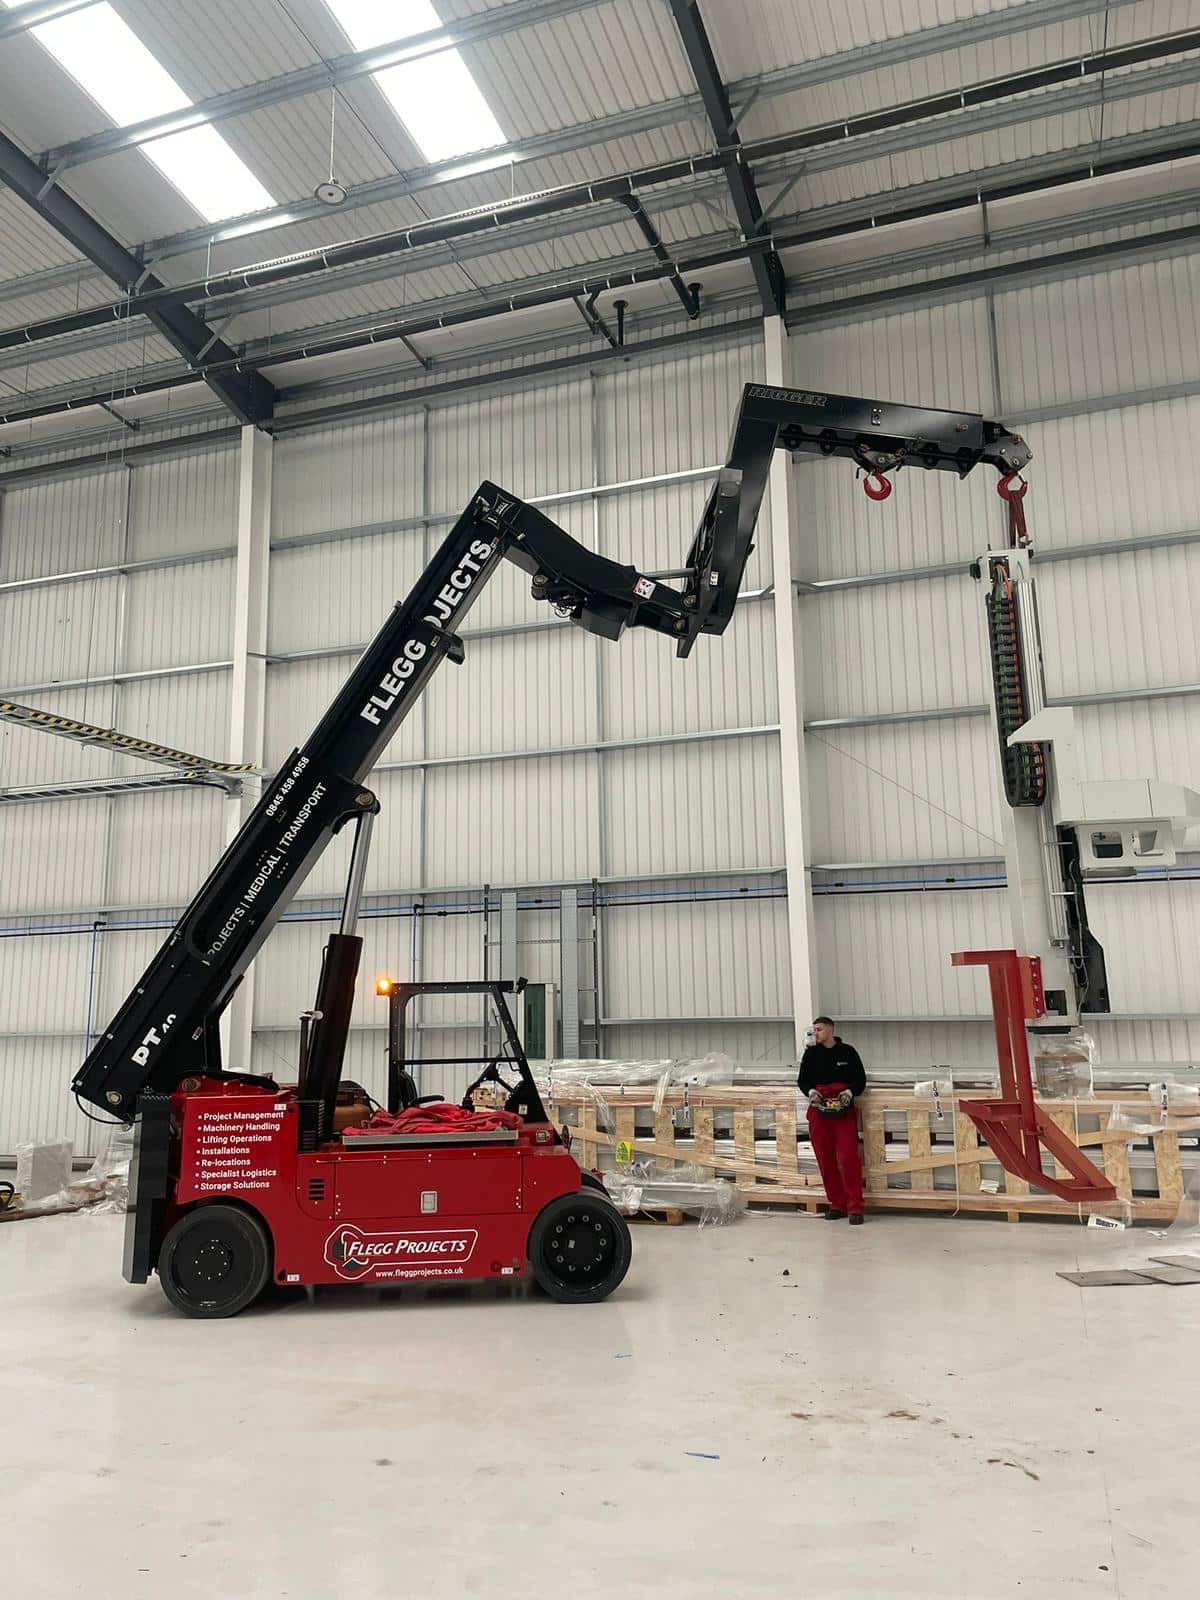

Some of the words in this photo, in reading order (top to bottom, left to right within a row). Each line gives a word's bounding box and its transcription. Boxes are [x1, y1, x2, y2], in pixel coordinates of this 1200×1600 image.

[360, 639, 426, 726] FLEGG
[265, 793, 284, 816] 0845
[281, 777, 295, 795] 458
[292, 756, 309, 778] 4958
[244, 853, 282, 903] MEDICAL
[279, 782, 327, 849] TRANSPORT
[131, 1026, 161, 1067] PT
[203, 1112, 232, 1122] Project
[233, 1111, 284, 1120] Management
[203, 1123, 244, 1133] Machinery
[245, 1122, 281, 1132] Handling
[202, 1135, 228, 1144] Lifting
[229, 1134, 272, 1144] Operations
[201, 1146, 250, 1155] Installations
[201, 1157, 251, 1167] Re-locations
[201, 1169, 240, 1180] Specialist
[241, 1168, 277, 1178] Logistics
[200, 1182, 232, 1191] Storage
[232, 1180, 270, 1189] Solutions
[348, 1241, 394, 1256] FLEGG
[395, 1239, 467, 1254] PROJECTS
[375, 1266, 464, 1278] www.fleggprojects.co.uk
